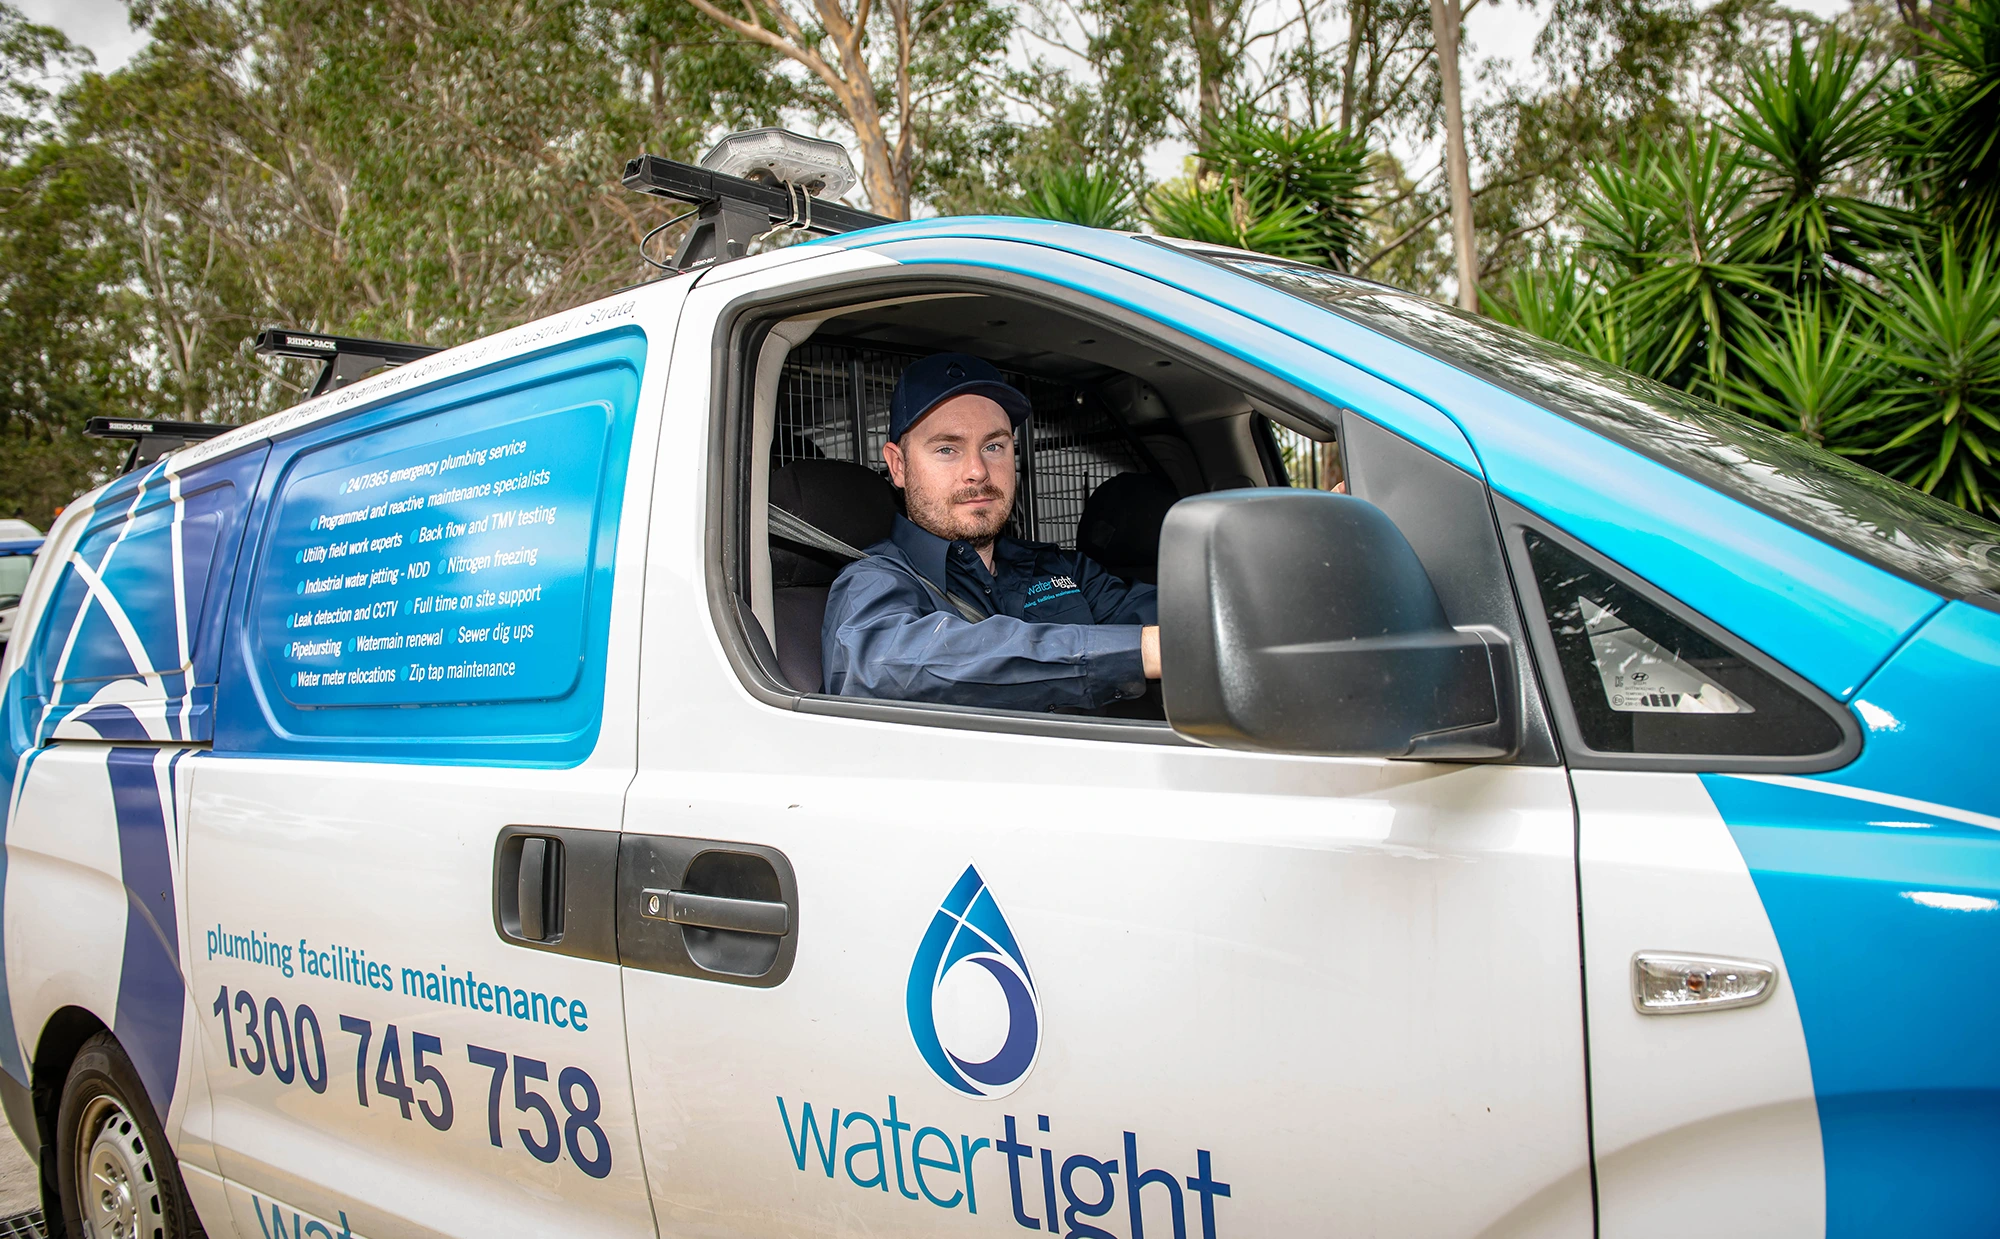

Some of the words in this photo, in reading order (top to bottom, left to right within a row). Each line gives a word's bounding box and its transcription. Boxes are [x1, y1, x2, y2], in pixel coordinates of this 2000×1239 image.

[286, 336, 337, 349] RHINO-RACK
[238, 414, 290, 441] Educaton
[336, 372, 407, 405] Government
[585, 300, 636, 326] Strata
[346, 469, 390, 494] 24/7/365
[389, 460, 440, 482] emergency
[439, 448, 488, 475] plumbing
[488, 438, 527, 461] service
[317, 505, 370, 531] Programmed
[369, 501, 389, 519] and
[388, 495, 425, 516] reactive
[427, 483, 491, 508] maintenance
[492, 468, 551, 497] specialists
[418, 523, 444, 544] Back
[445, 521, 467, 539] flow
[467, 515, 489, 535] and
[491, 509, 517, 531] TMV
[517, 504, 557, 525] testing
[302, 545, 328, 564] Utility
[328, 541, 349, 559] field
[348, 537, 369, 555] work
[370, 532, 403, 553] experts
[447, 555, 491, 575] Nitrogen
[493, 546, 539, 567] freezing
[304, 573, 344, 594] Industrial
[344, 571, 369, 588] water
[368, 566, 400, 589] jetting
[406, 560, 431, 580] NDD
[293, 611, 313, 628] Leak
[313, 606, 353, 626] detection
[353, 603, 372, 621] and
[372, 599, 399, 619] CCTV
[413, 596, 434, 615] Full
[434, 594, 458, 613] time
[460, 594, 474, 610] on
[475, 588, 496, 608] site
[497, 583, 542, 608] support
[290, 638, 343, 660] Pipebursting
[356, 631, 404, 653] Watermain
[405, 627, 444, 648] renewal
[457, 625, 491, 644] Sewer
[492, 622, 511, 644] dig
[513, 623, 534, 643] ups
[297, 671, 321, 687] Water
[321, 669, 347, 686] meter
[347, 665, 397, 685] relocations
[408, 663, 426, 683] Zip
[427, 663, 445, 681] tap
[446, 660, 516, 679] maintenance
[206, 923, 294, 979] plumbing
[298, 938, 395, 992] facilities
[400, 963, 590, 1033] maintenance
[212, 984, 329, 1096] 1300
[338, 1013, 455, 1133] 745
[465, 1042, 614, 1181] 758
[776, 1094, 1232, 1239] watertight
